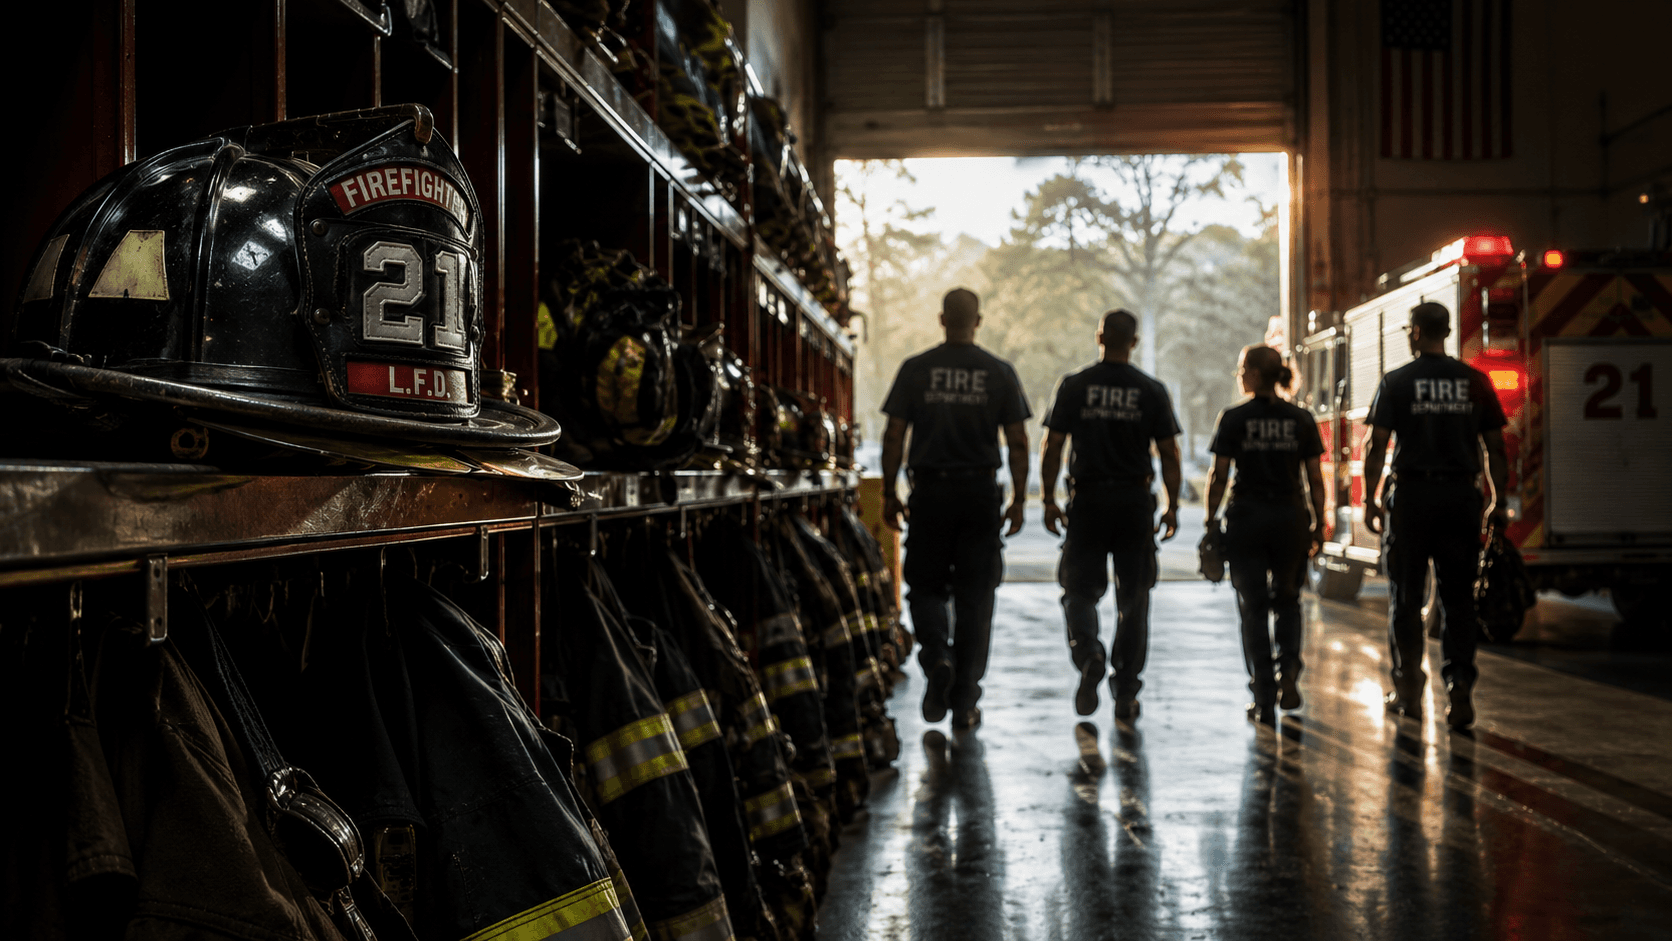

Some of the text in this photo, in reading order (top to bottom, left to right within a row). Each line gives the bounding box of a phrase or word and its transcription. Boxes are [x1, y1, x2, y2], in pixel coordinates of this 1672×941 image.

[341, 168, 467, 227] FIREFIGHTER
[363, 241, 467, 350] 21
[389, 366, 451, 397] L.F.D.
[930, 367, 988, 391] FIRE
[1414, 378, 1470, 401] FIRE
[1583, 362, 1656, 419] 21
[1086, 384, 1141, 408] FIRE
[1246, 418, 1297, 439] FIRE
